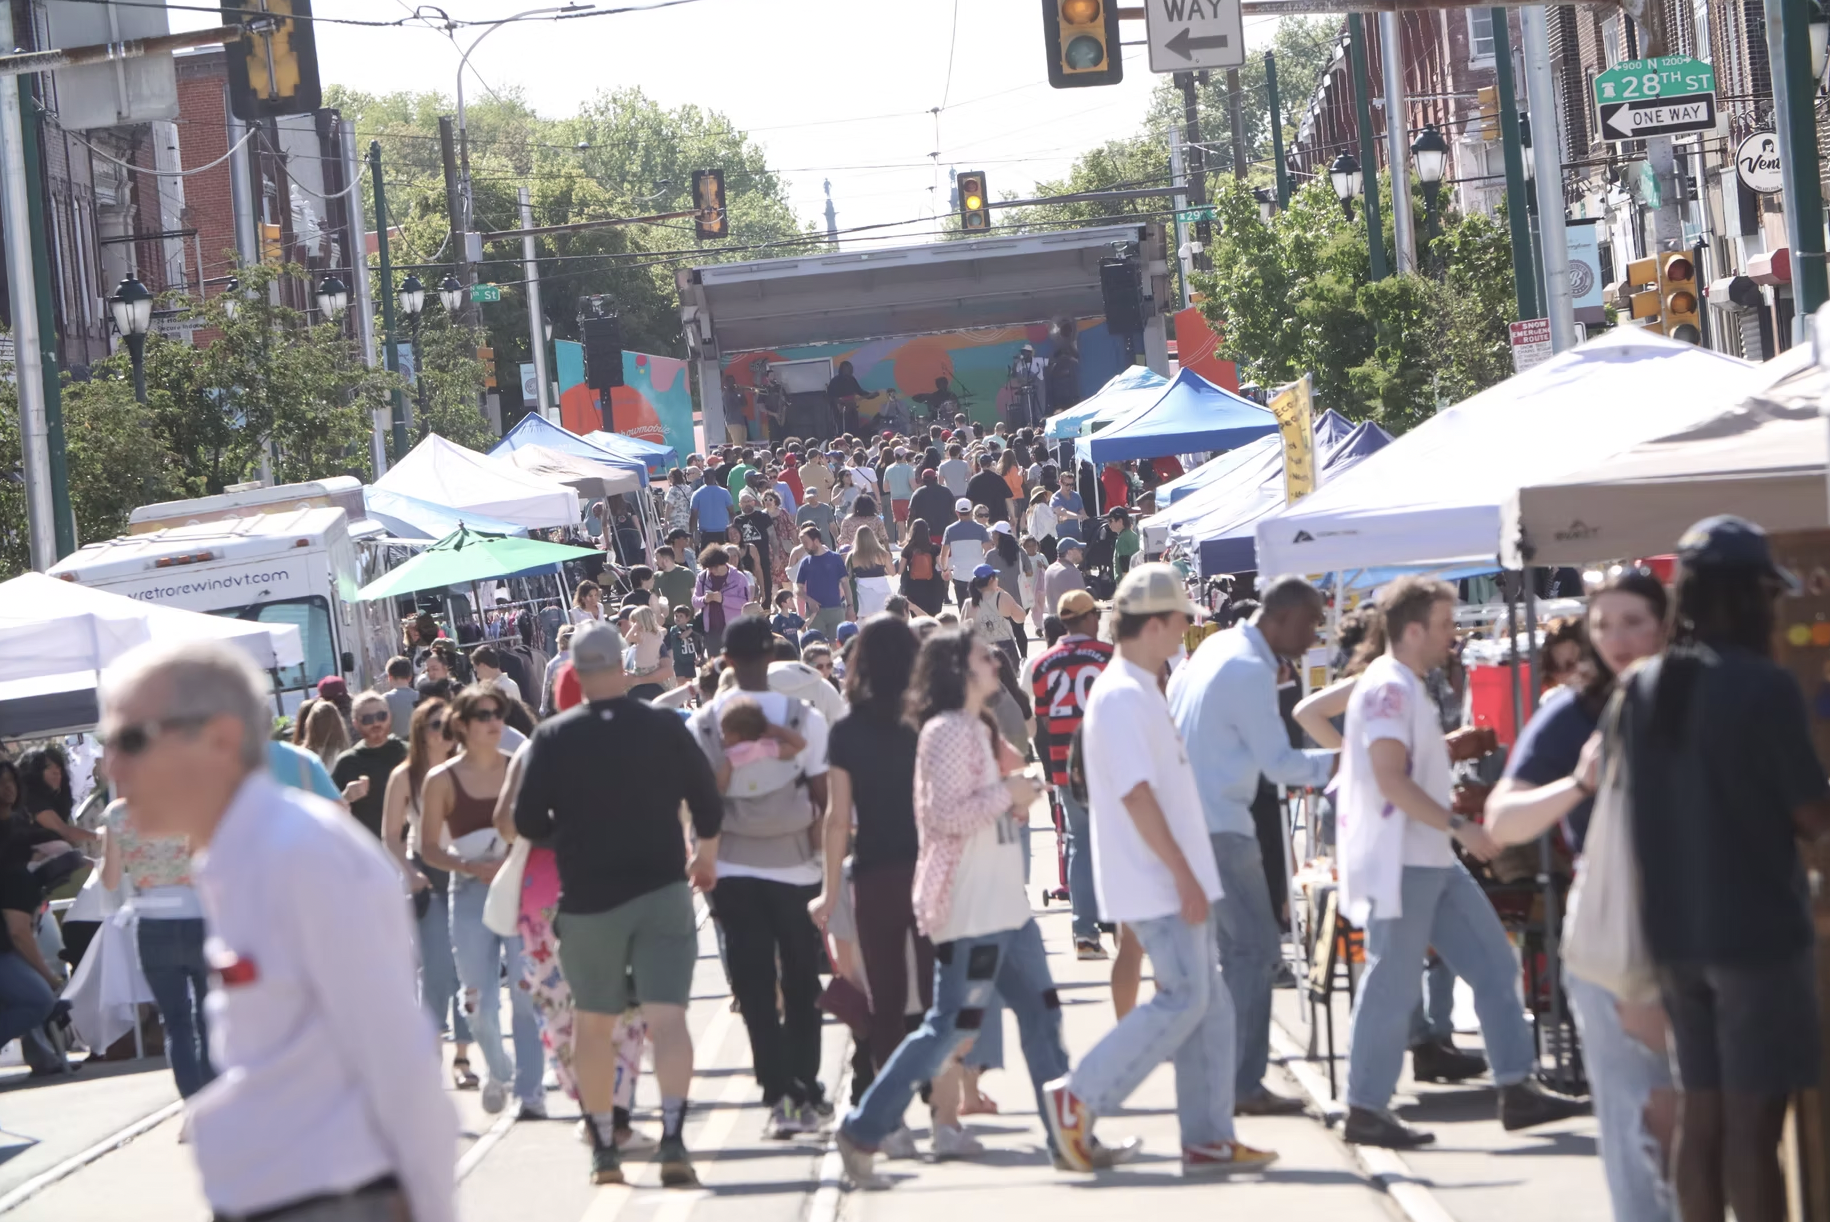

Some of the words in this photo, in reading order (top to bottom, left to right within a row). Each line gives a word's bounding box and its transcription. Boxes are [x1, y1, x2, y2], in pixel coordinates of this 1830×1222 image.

[1163, 0, 1221, 22] WAY
[1622, 61, 1642, 71] 900
[1647, 58, 1658, 70] N
[1662, 57, 1683, 66] 1200
[1621, 71, 1682, 98] 28TH
[1685, 74, 1711, 91] ST
[1633, 109, 1664, 126] ONE
[1669, 104, 1701, 122] WAY
[484, 290, 496, 300] St
[1512, 328, 1550, 338] EMERGENC
[1522, 320, 1546, 329] SNOW
[1524, 334, 1549, 342] ROUTE
[128, 570, 288, 600] retrorewindvt.com
[1047, 665, 1102, 717] 20
